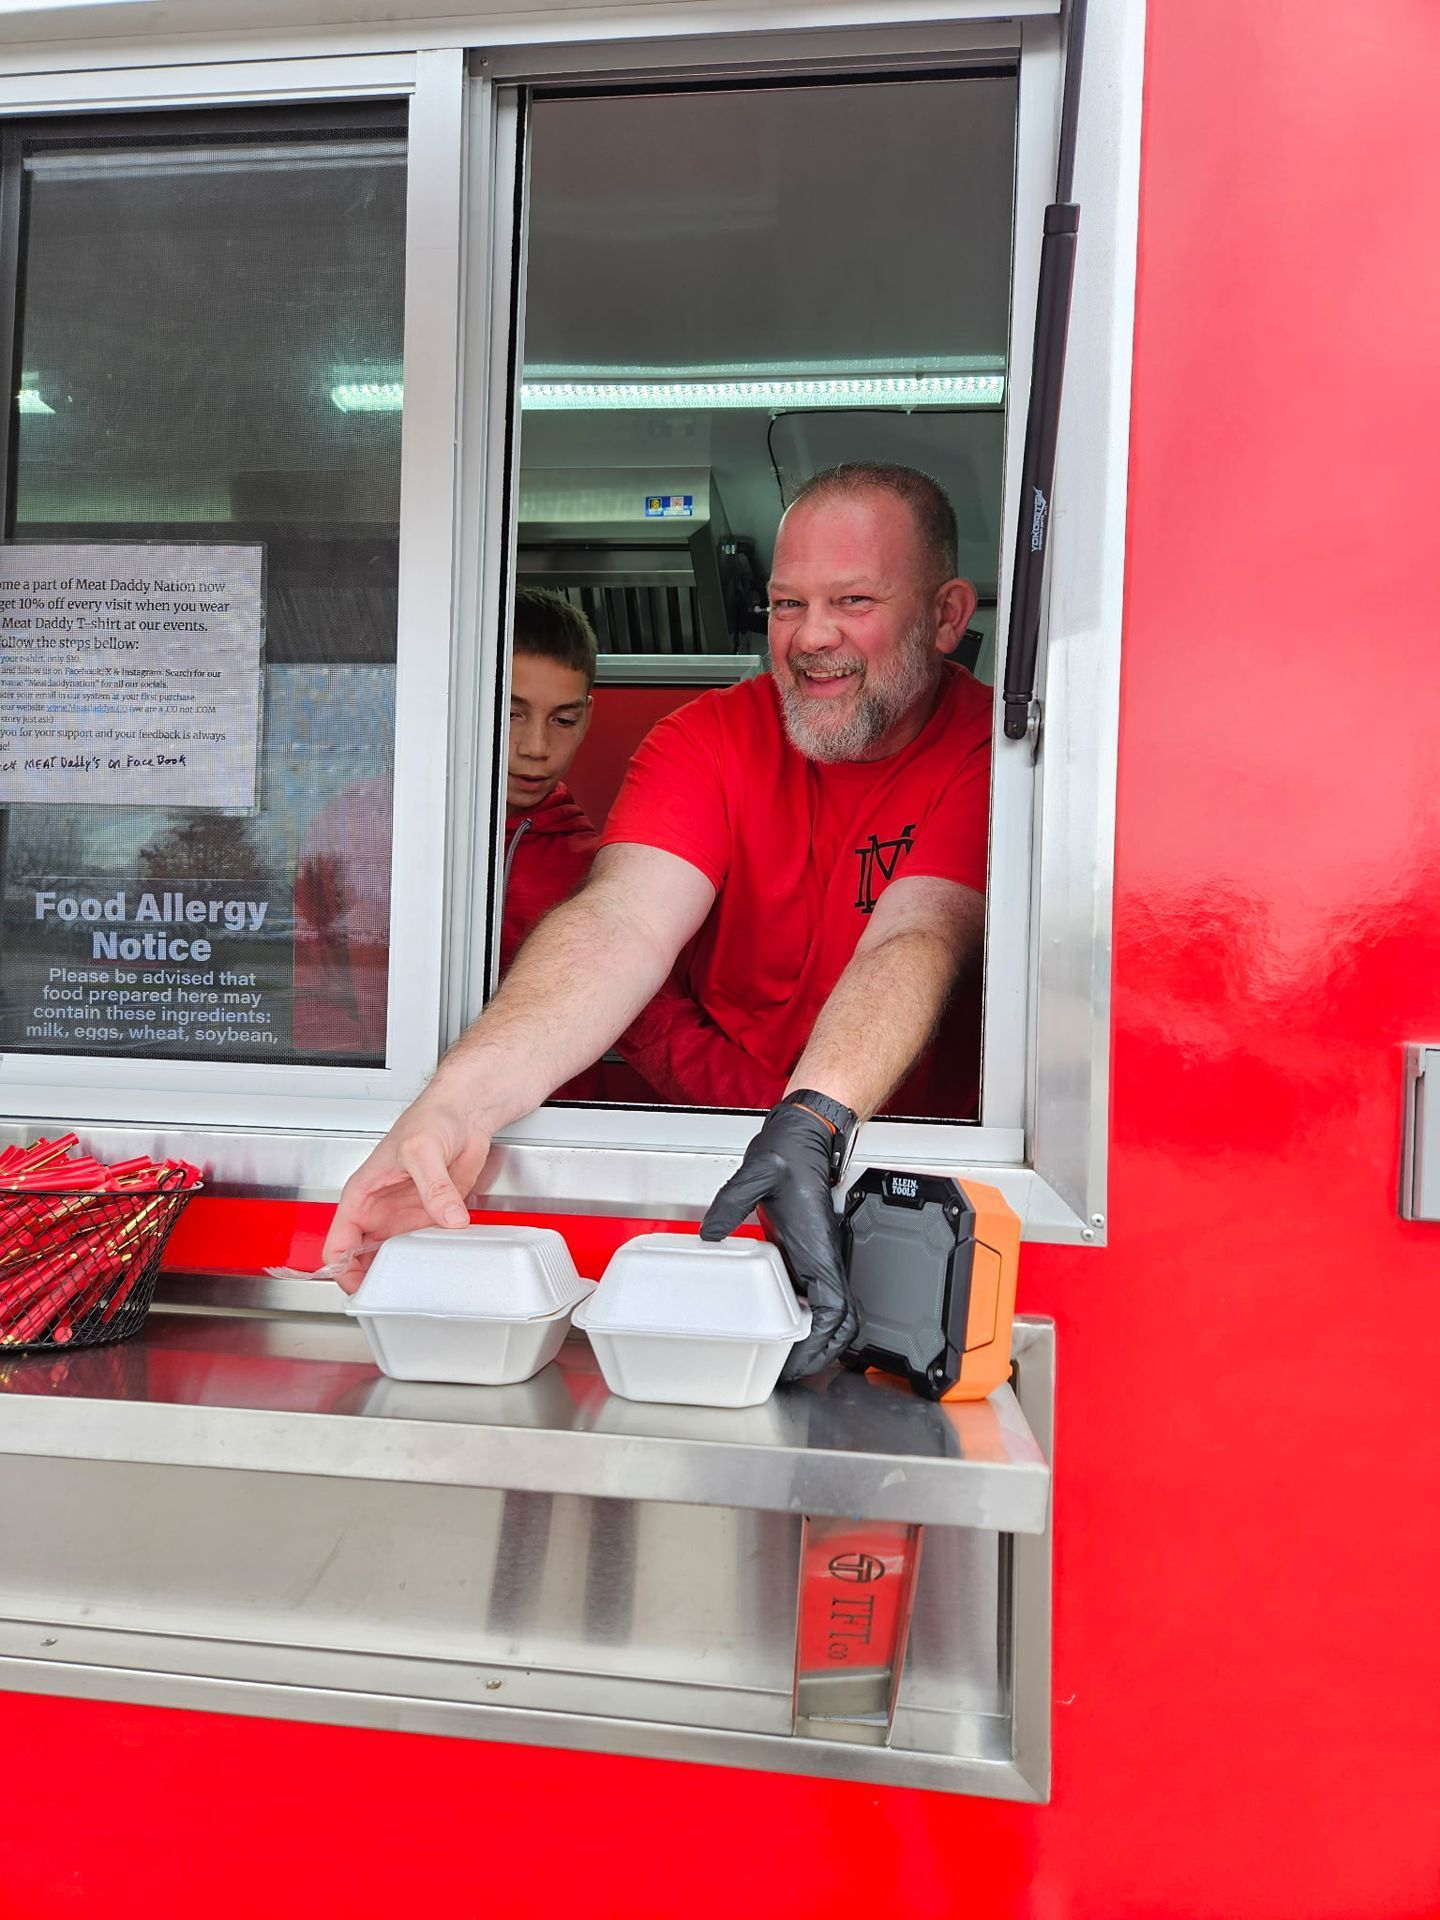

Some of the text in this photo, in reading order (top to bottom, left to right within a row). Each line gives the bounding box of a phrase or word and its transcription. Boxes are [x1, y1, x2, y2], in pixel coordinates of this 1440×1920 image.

[0, 577, 226, 594] me a part of Meat Daddy Nation now
[20, 598, 45, 610] 10%
[48, 597, 65, 609] off
[67, 600, 102, 613] every
[105, 598, 132, 611] visit
[136, 599, 170, 611] when
[173, 602, 196, 614] you
[200, 602, 231, 612] wear
[2, 617, 209, 631] Meat Daddy T-shirt at our events.
[0, 636, 139, 651] ollow the steps bellow:
[165, 669, 193, 678] Search
[194, 668, 206, 678] for
[207, 670, 221, 678] our
[100, 680, 113, 688] for
[0, 726, 226, 742] you for your support and your feedback is always
[24, 755, 57, 770] MEAT
[127, 754, 155, 768] Face
[35, 891, 269, 931] Food Allergy
[92, 931, 212, 962] Notice
[49, 967, 257, 986] Please be advised that
[42, 985, 262, 1009] food prepared here may
[33, 1004, 271, 1024] contain these ingredients:
[26, 1021, 279, 1045] milk, eggs, wheat, soybean,
[892, 1177, 917, 1189] KLEIN
[892, 1185, 917, 1197] TOOLS
